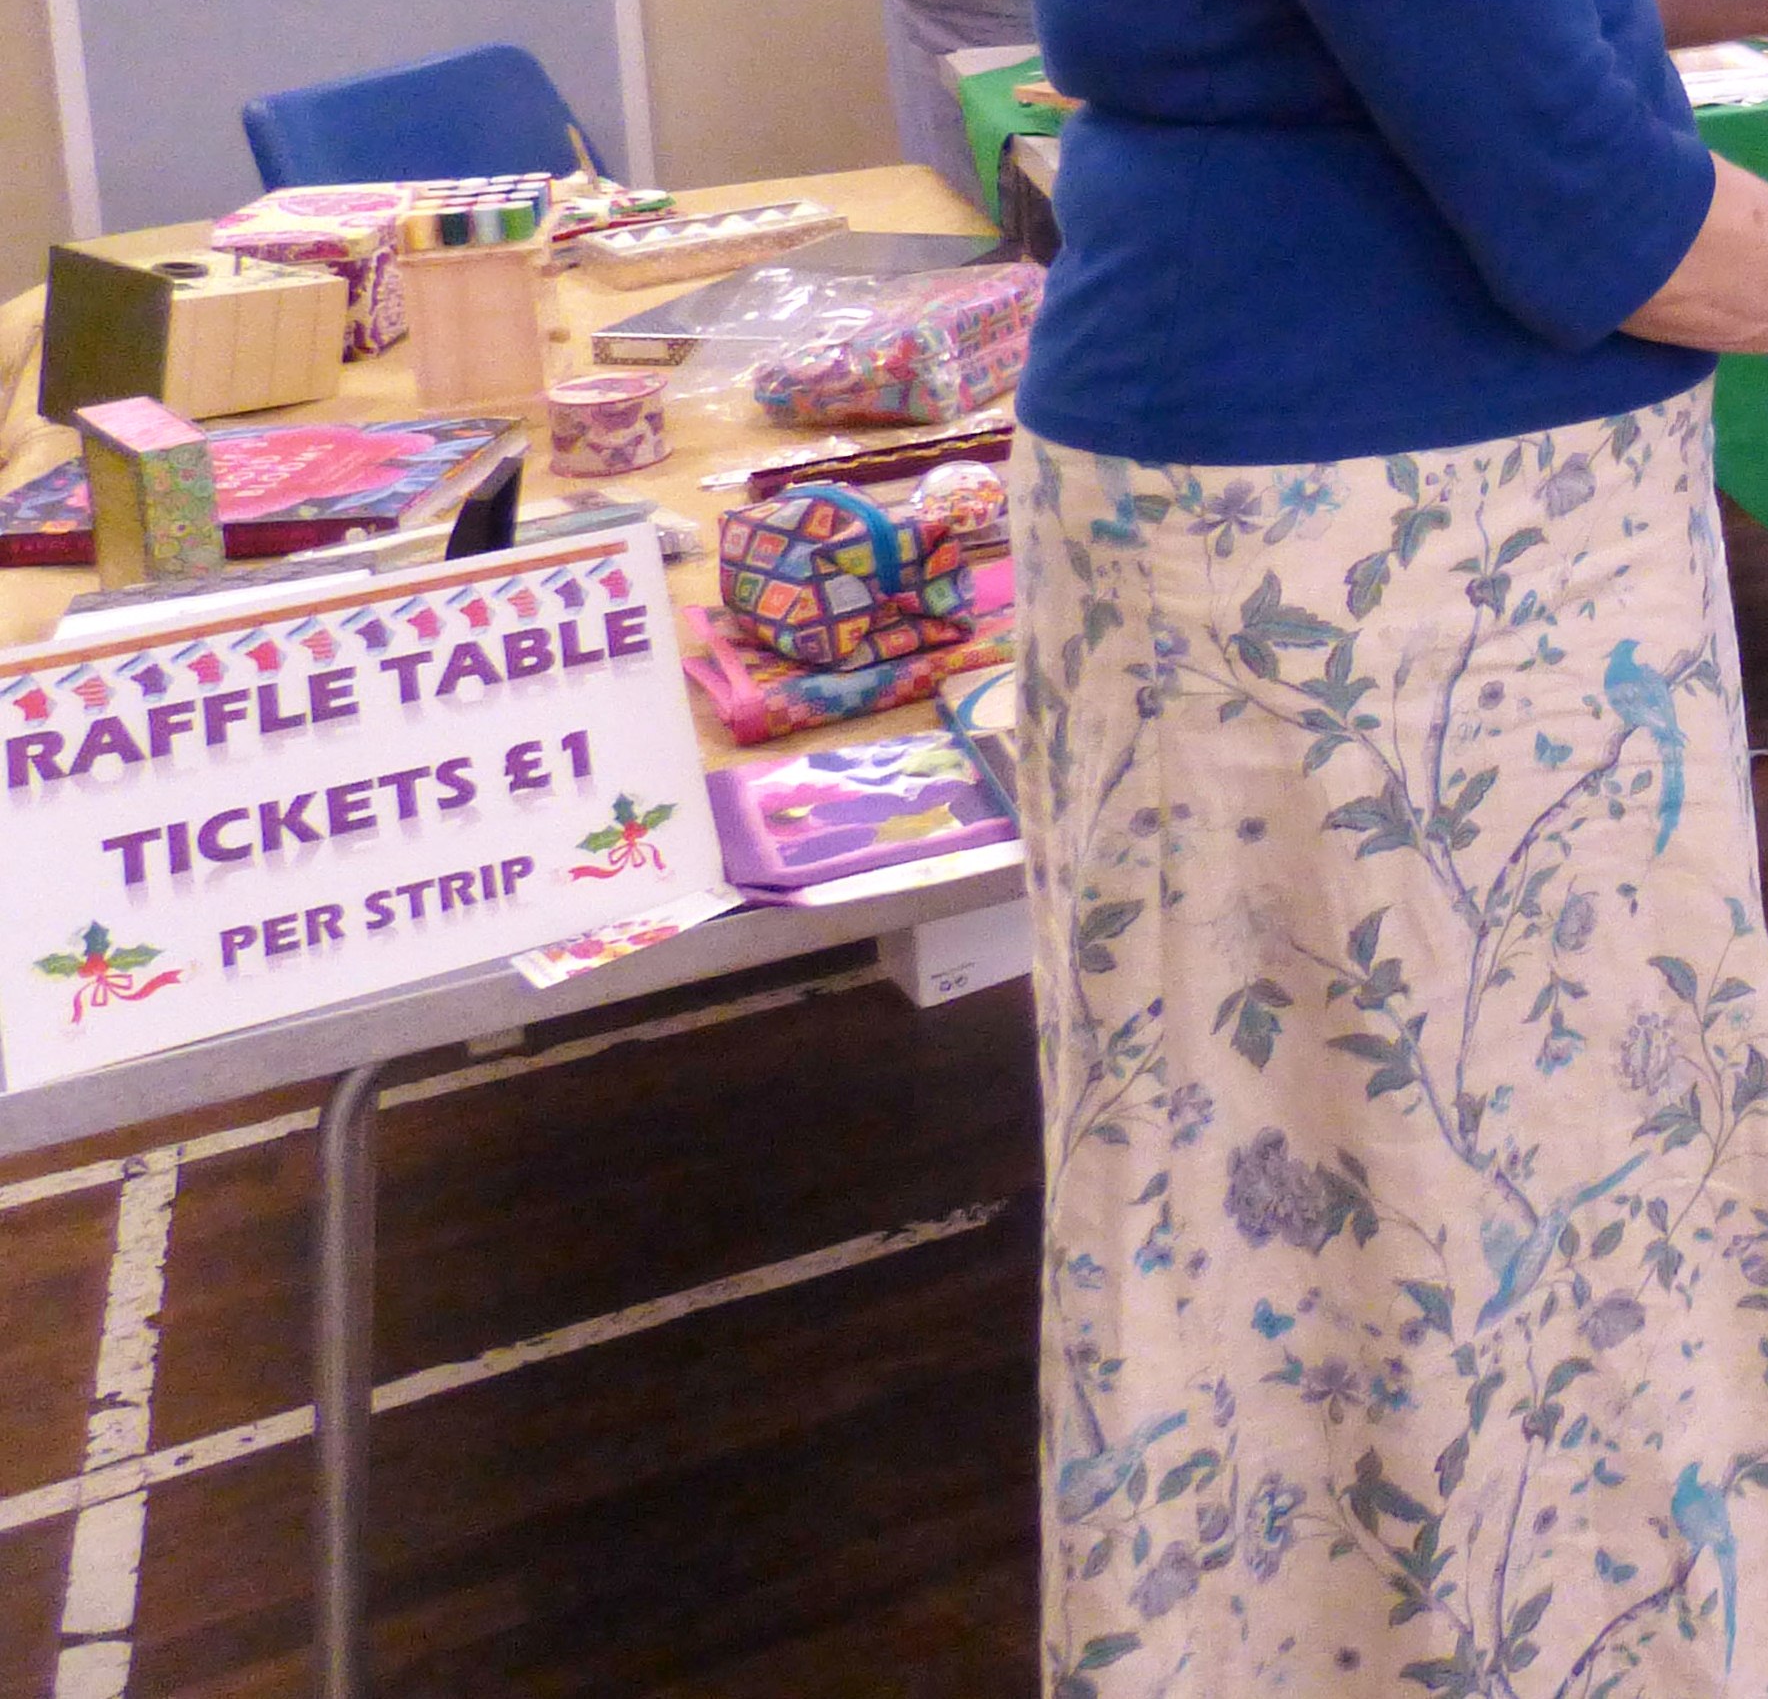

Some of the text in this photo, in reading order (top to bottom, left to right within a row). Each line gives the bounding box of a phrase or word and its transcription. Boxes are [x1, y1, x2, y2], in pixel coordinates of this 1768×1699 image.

[6, 605, 651, 789] RAFFLE TABLE
[102, 730, 593, 887] TICKETS £1
[220, 856, 536, 968] PER STRIP
